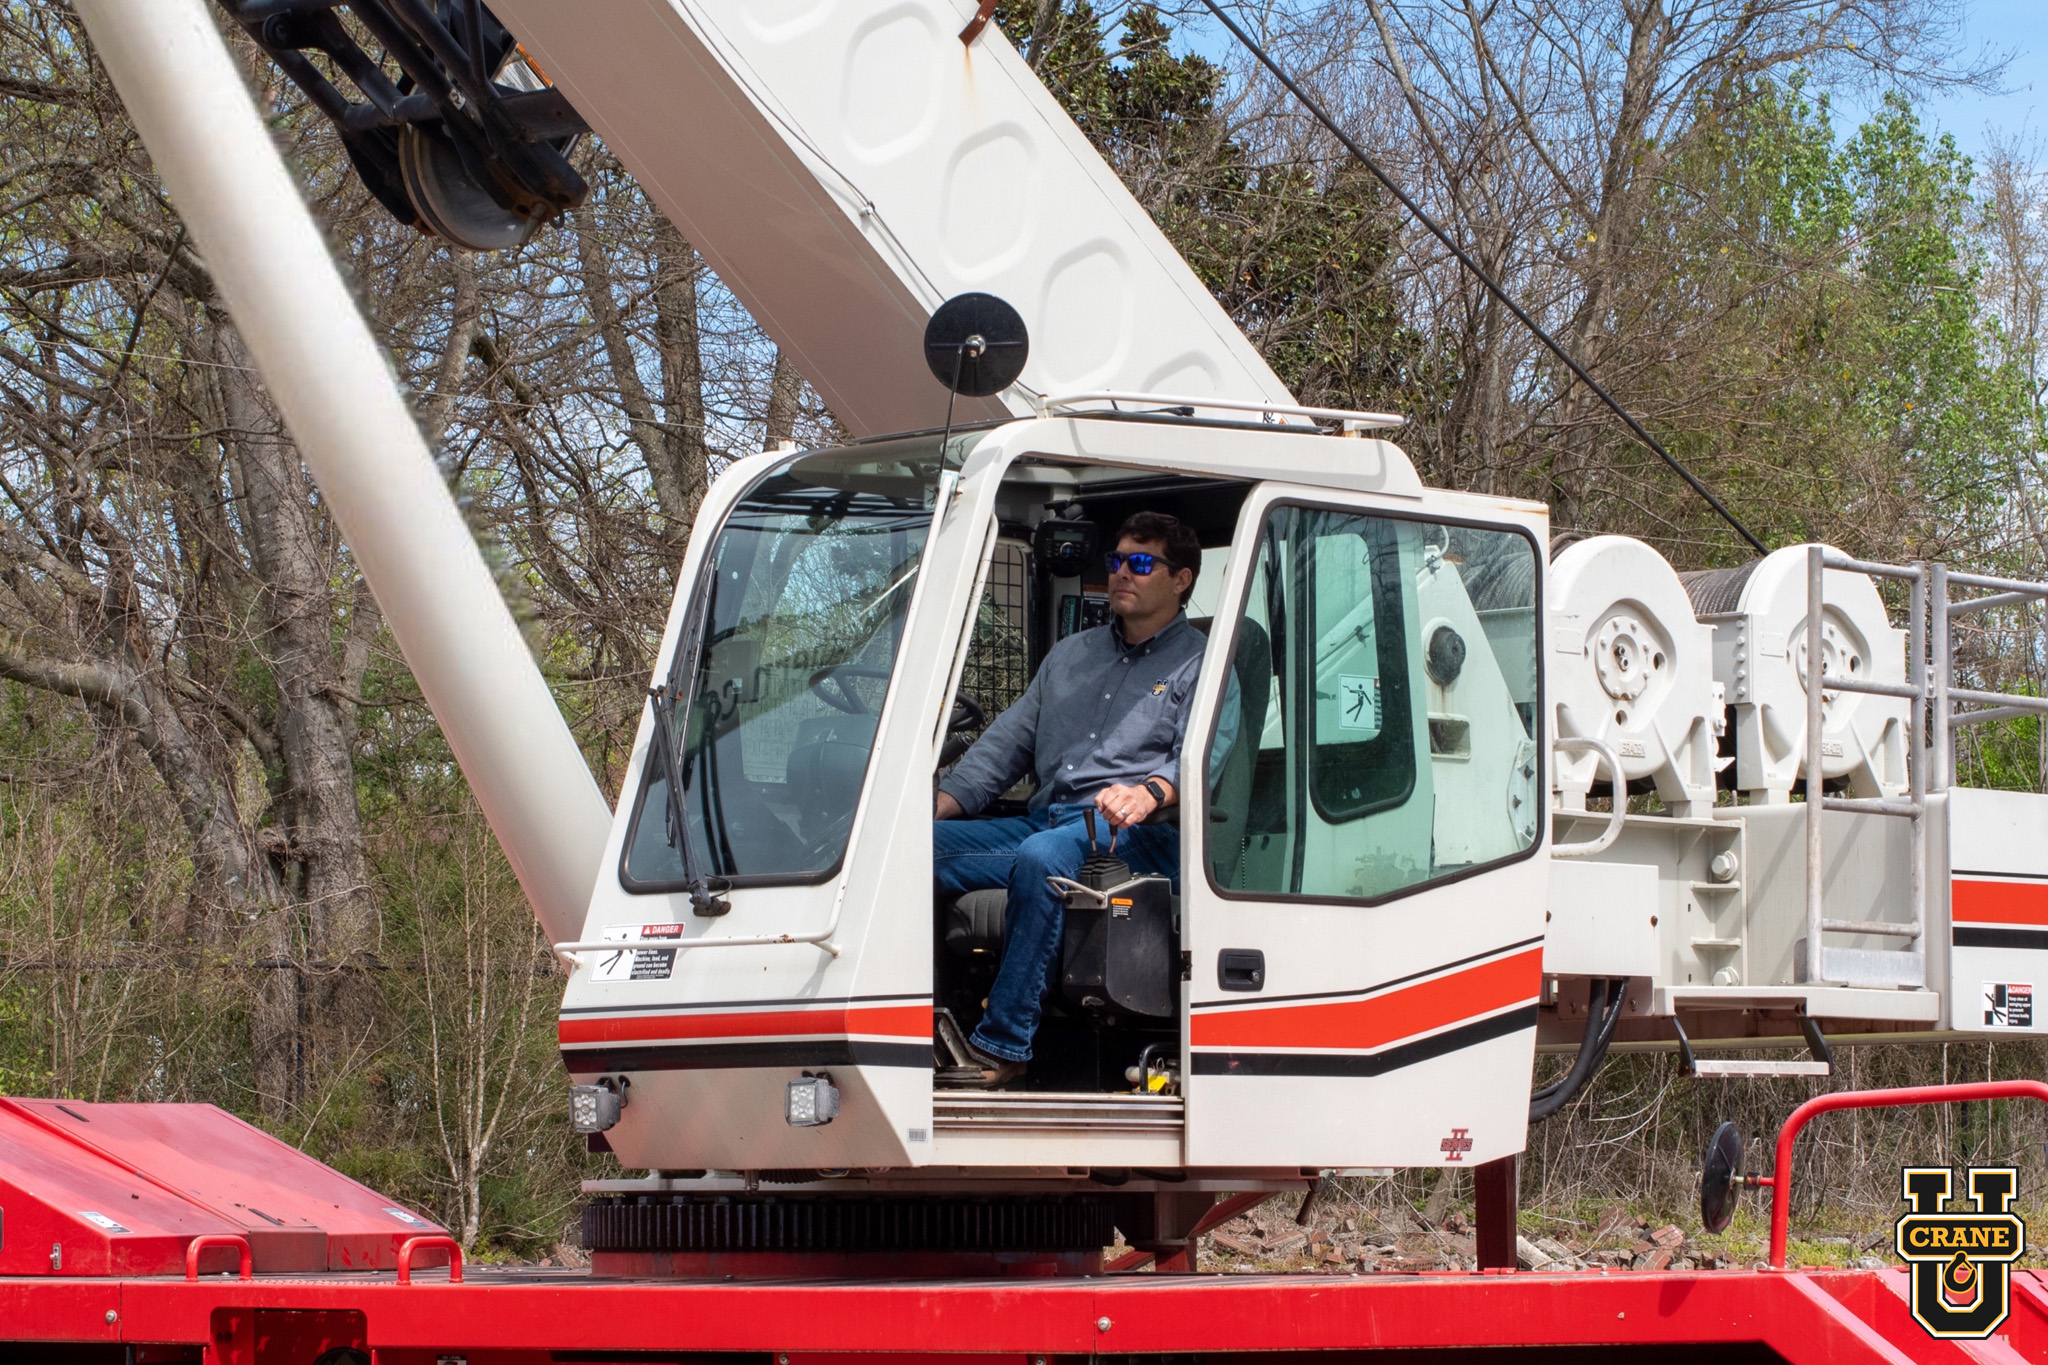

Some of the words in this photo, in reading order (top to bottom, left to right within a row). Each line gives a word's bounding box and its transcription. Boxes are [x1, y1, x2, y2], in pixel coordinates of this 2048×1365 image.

[652, 925, 679, 934] DANGER
[633, 962, 646, 970] ground
[2011, 986, 2032, 994] DANGER
